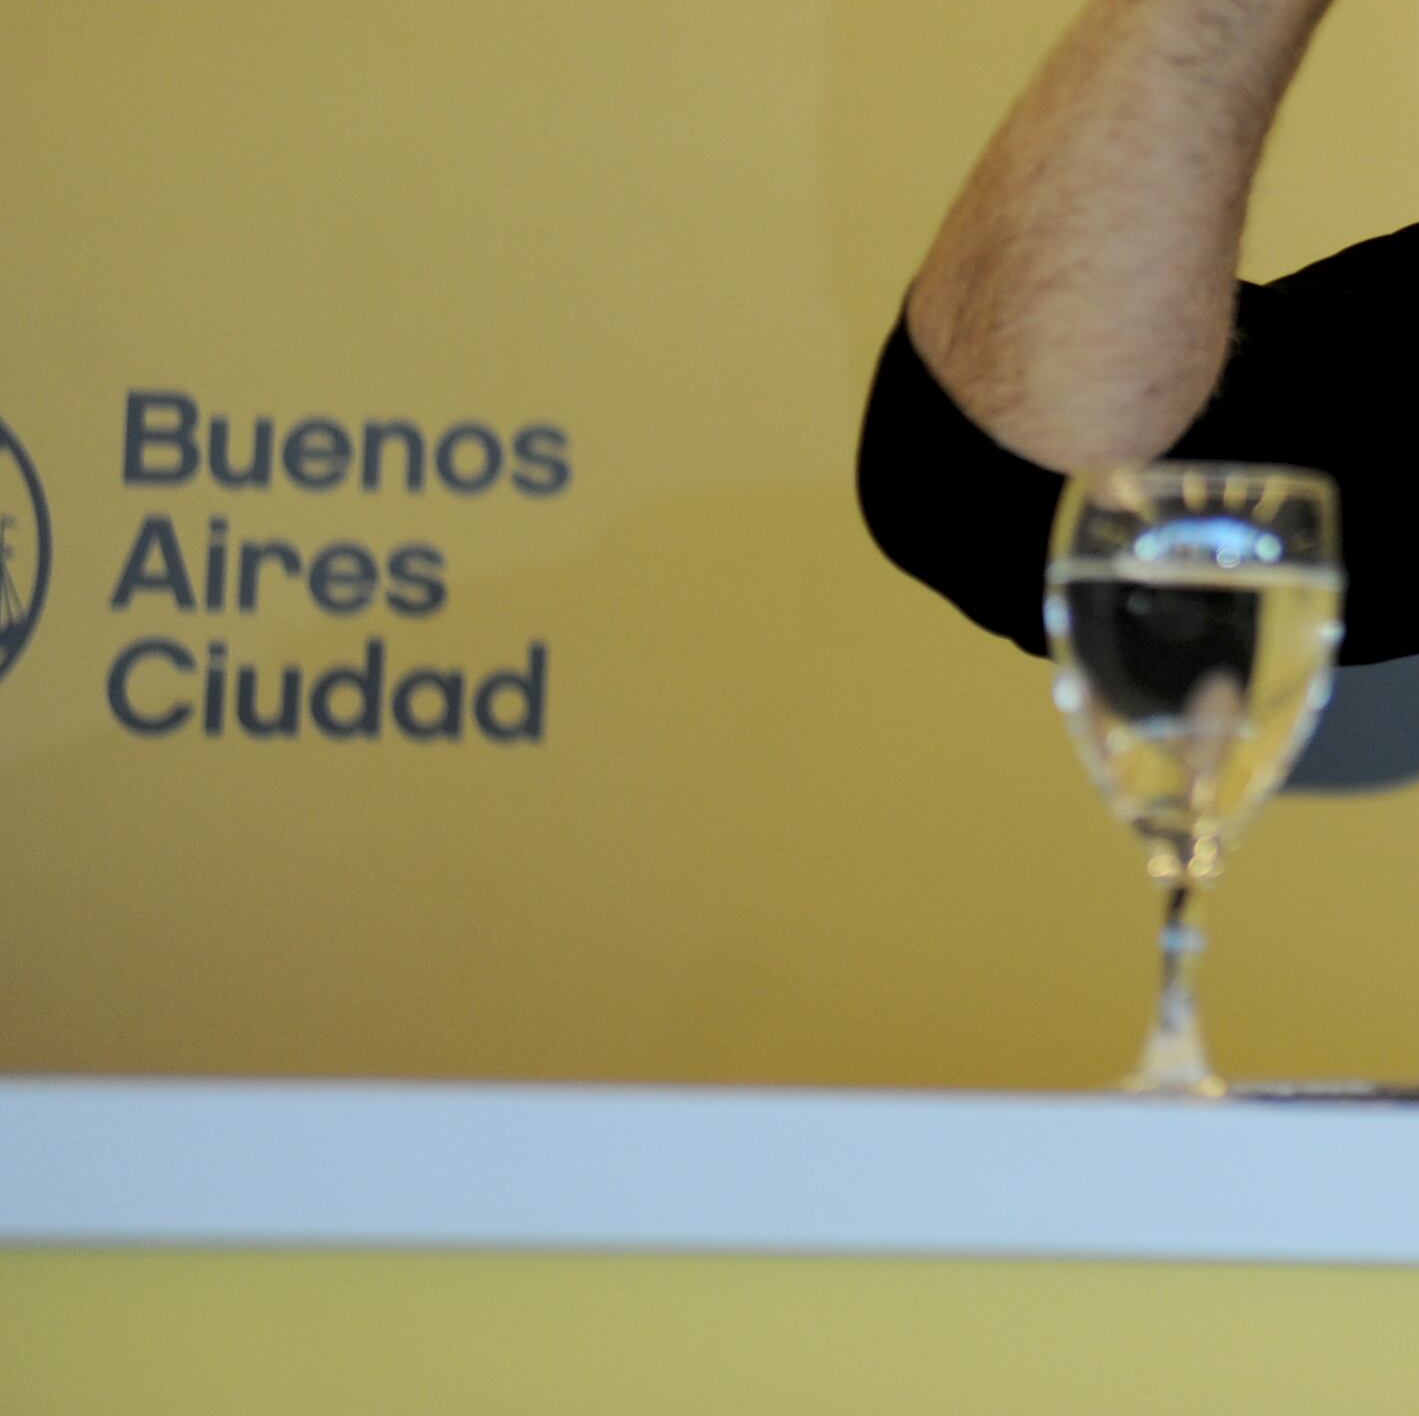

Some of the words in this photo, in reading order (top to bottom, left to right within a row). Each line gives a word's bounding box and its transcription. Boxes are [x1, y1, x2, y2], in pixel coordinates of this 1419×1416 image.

[122, 388, 573, 497] Buenos
[110, 514, 448, 618] Aires
[106, 636, 548, 743] Ciudad
